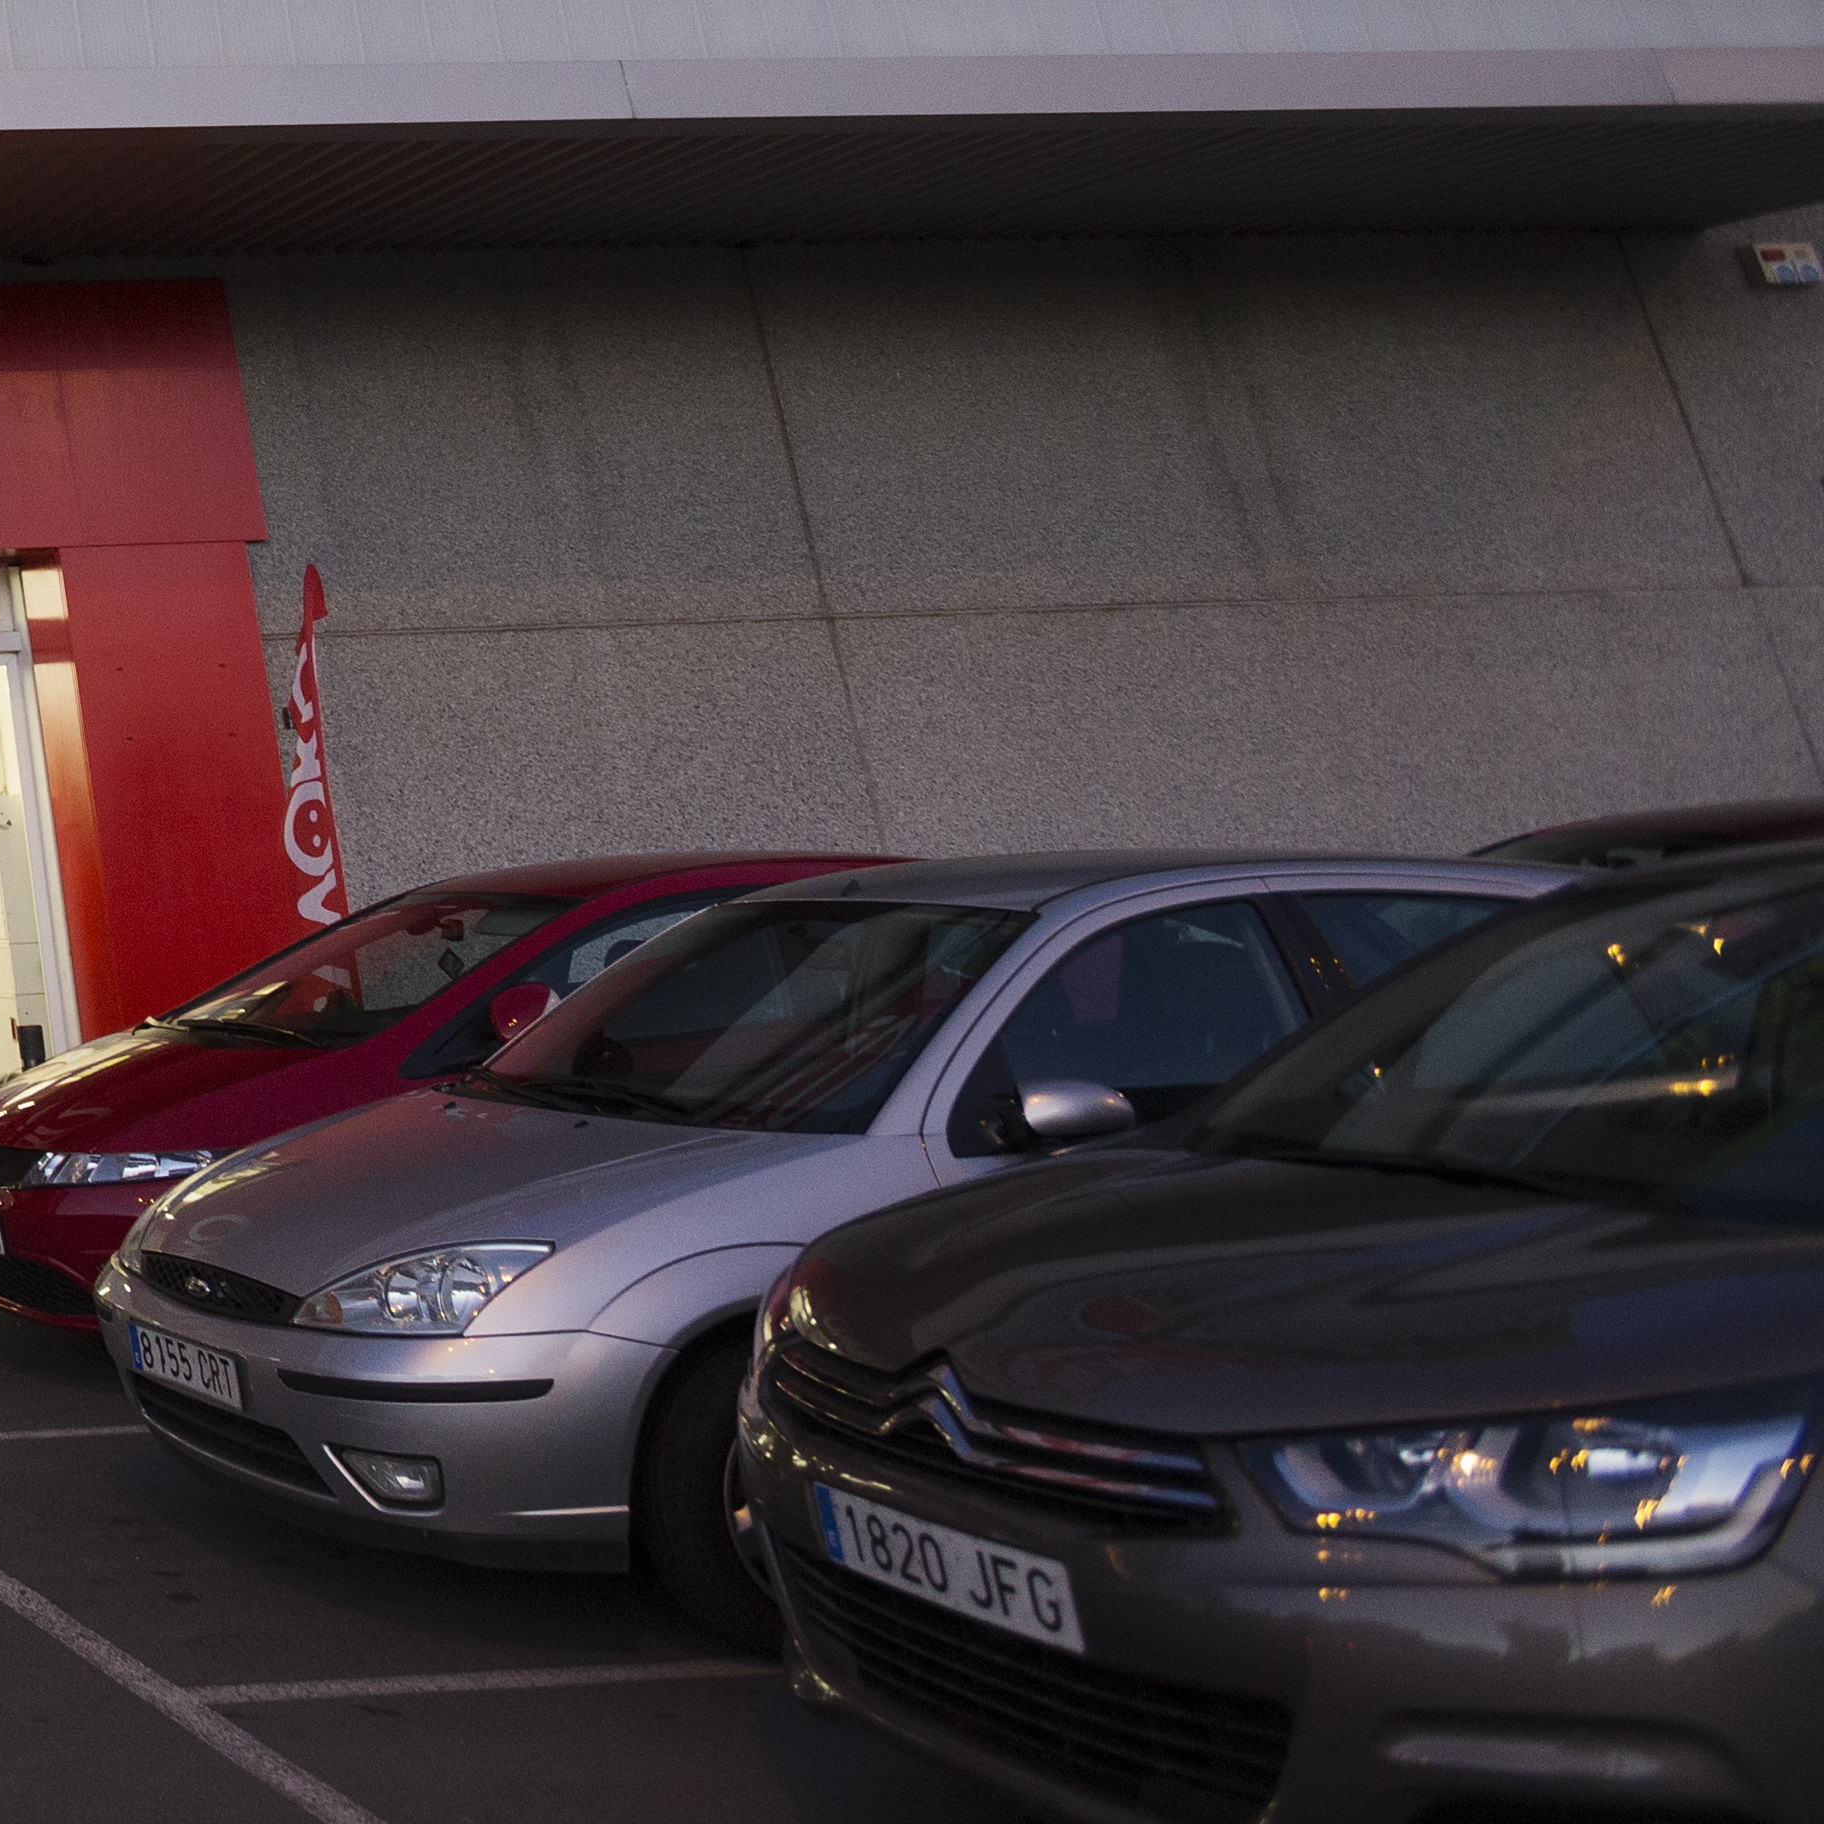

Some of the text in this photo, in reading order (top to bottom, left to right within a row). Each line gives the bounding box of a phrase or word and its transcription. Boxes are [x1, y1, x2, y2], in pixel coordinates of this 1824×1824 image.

[140, 1331, 234, 1400] 8155 CRT
[846, 1504, 1063, 1633] 1820 JFG
